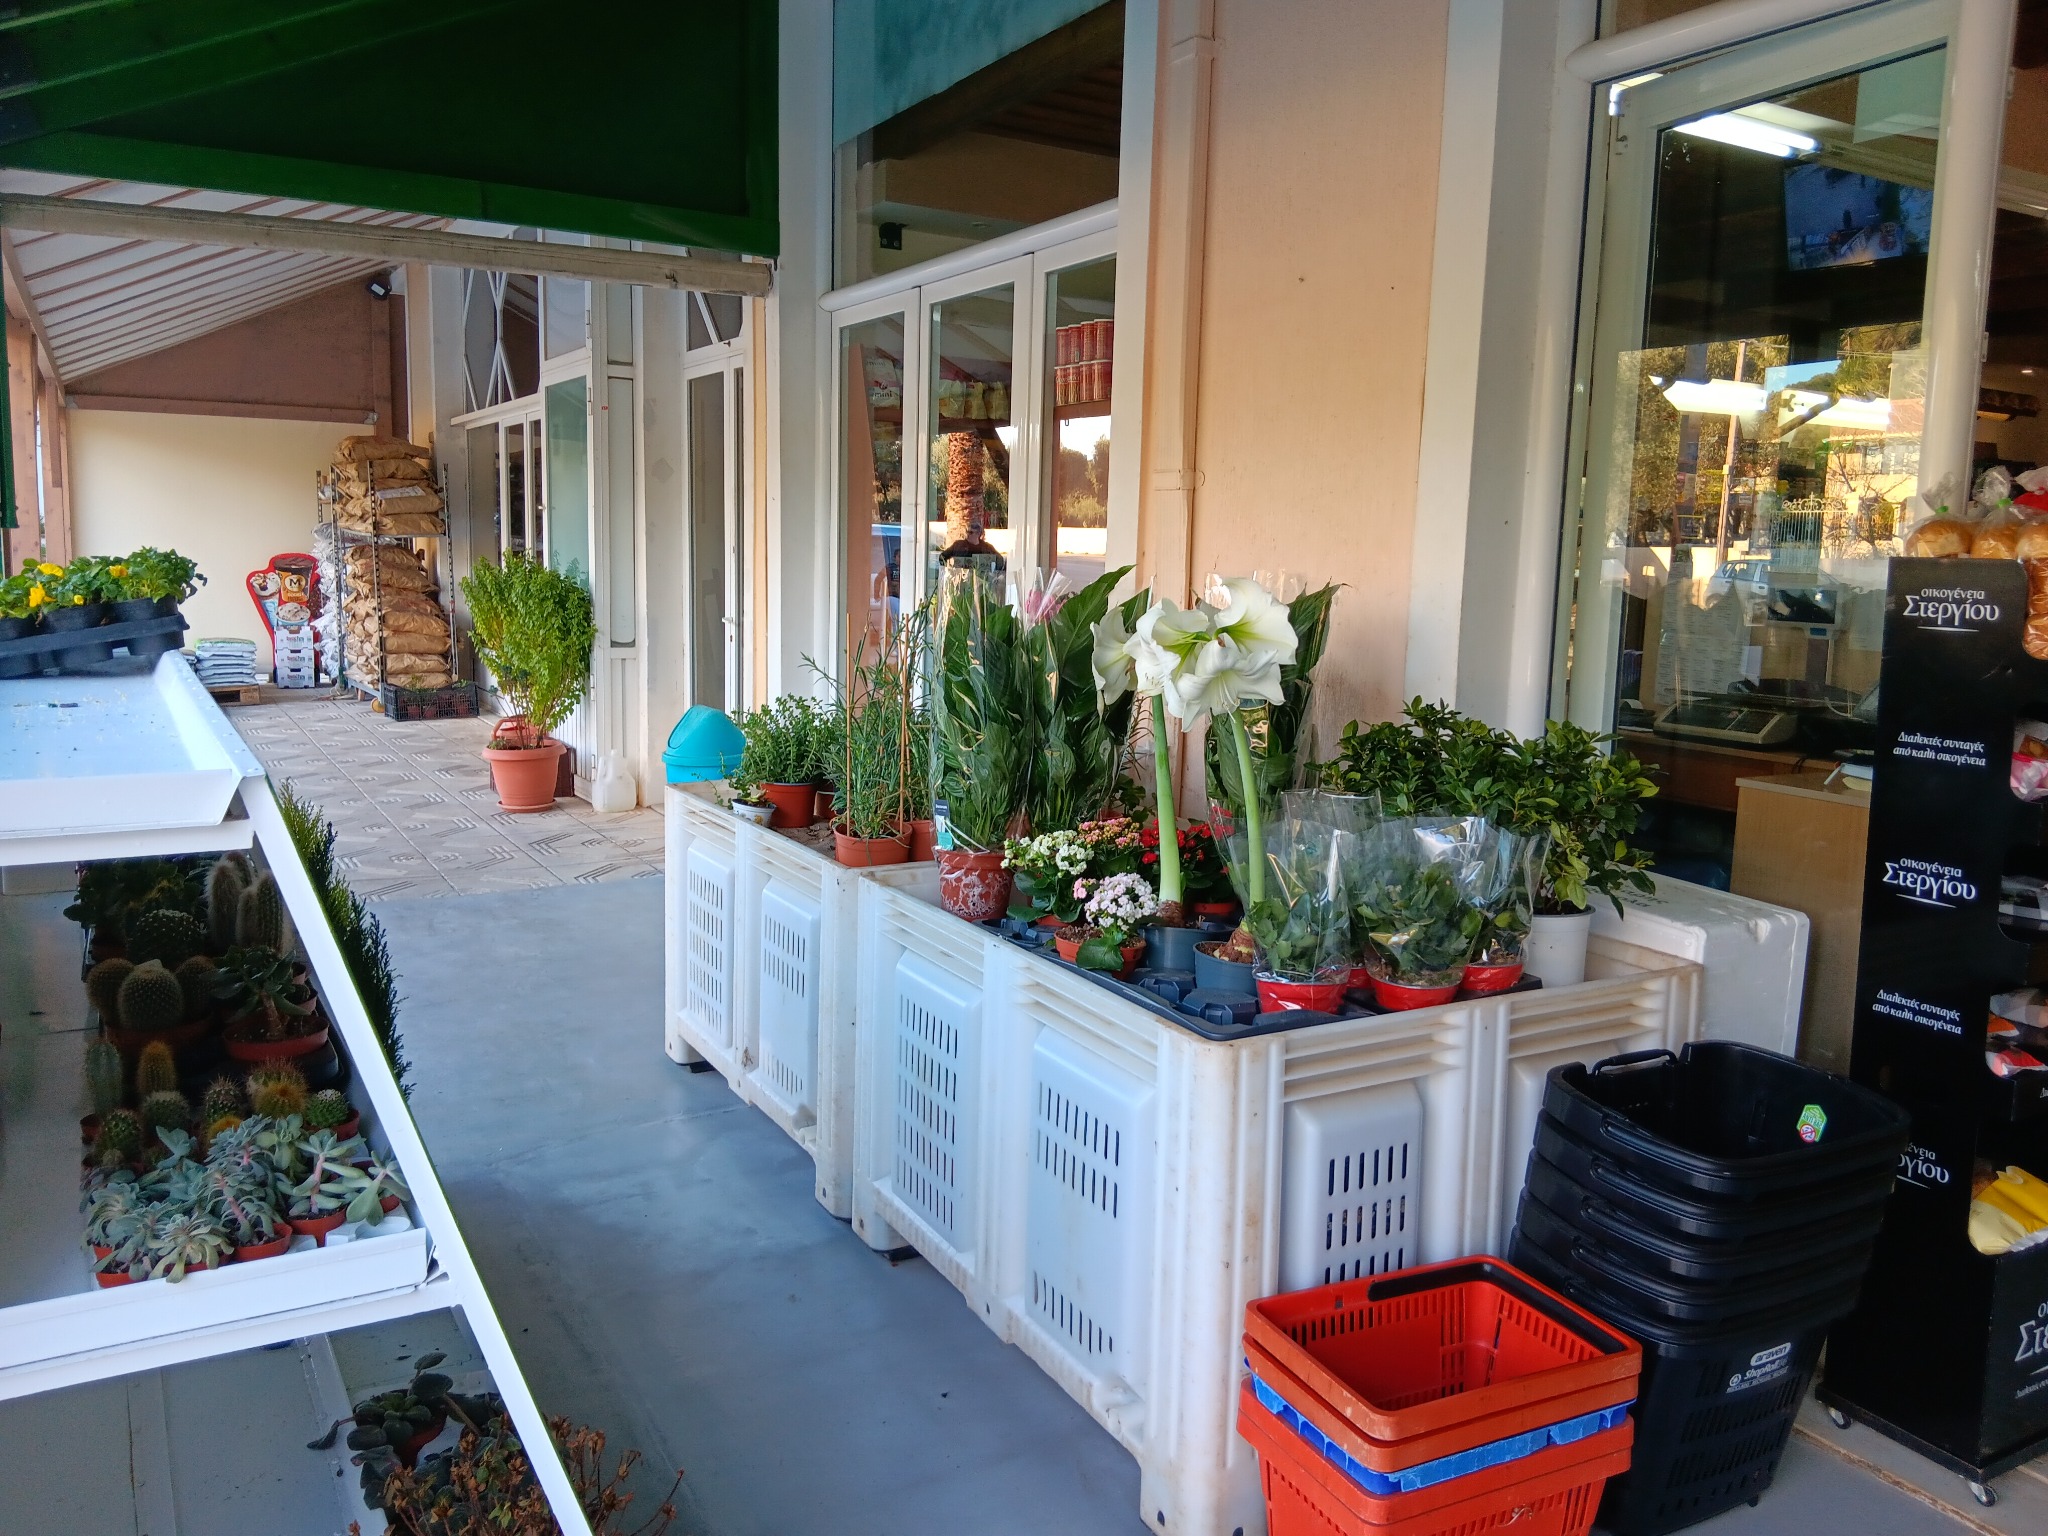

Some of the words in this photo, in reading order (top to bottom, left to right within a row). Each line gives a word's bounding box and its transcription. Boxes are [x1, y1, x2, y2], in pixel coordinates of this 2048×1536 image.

[1920, 587, 1985, 601] οικογένεια
[1902, 595, 1999, 626] Στεργίου
[1897, 731, 1943, 747] Διαλεκτές
[1942, 739, 1985, 753] συνταγές
[1892, 746, 1911, 756] από
[1911, 747, 1935, 759] καλή
[1937, 752, 1986, 766] οικογένεια
[1899, 858, 1962, 877] οικογένεια
[1882, 861, 1976, 900] Στεργίου
[1876, 989, 1920, 1010] Διαλεκτές
[1920, 1003, 1961, 1021] συνταγές
[1872, 1003, 1890, 1014] από
[1890, 1007, 1913, 1021] καλή
[1914, 1015, 1962, 1035] οικογένεια
[1907, 1142, 1936, 1160] ένεια
[1754, 1345, 1787, 1363] araven
